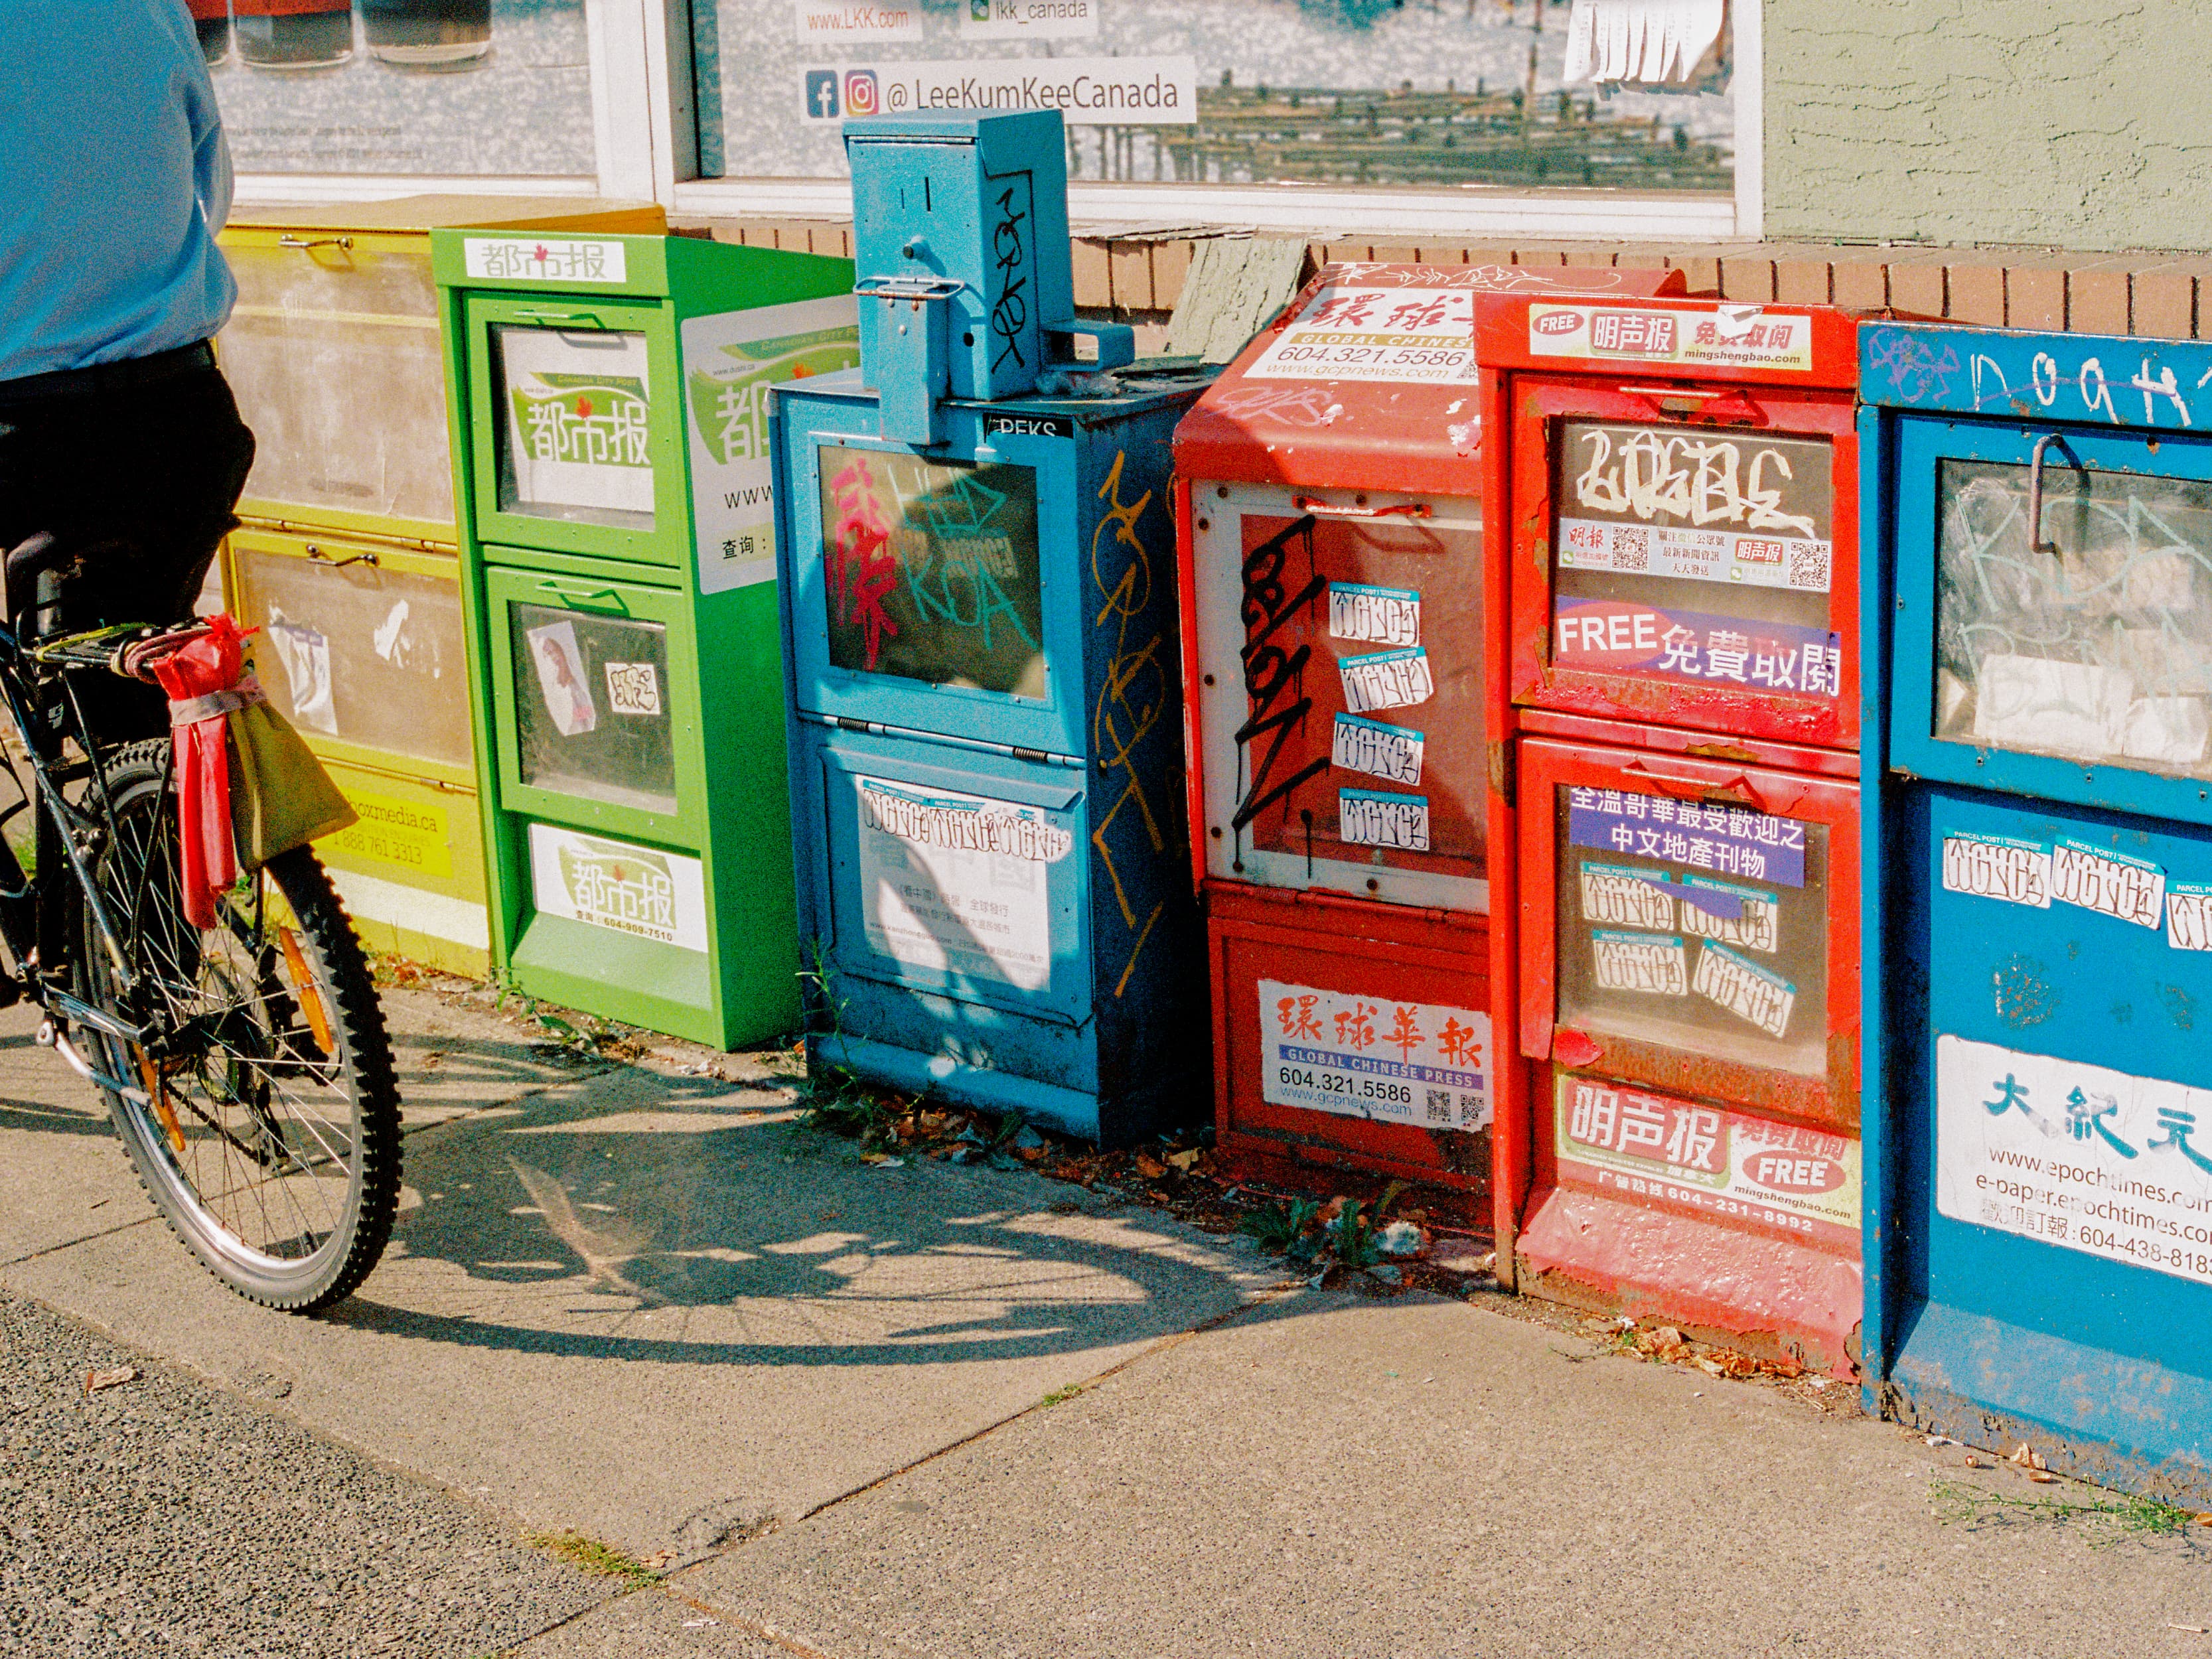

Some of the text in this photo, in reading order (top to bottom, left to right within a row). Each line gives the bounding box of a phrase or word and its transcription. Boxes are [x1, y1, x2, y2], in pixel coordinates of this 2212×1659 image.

[807, 9, 909, 31] www.LKK.com
[995, 1, 1088, 25] lkk_canada
[916, 74, 1179, 109] LeeKumKeeCanada
[481, 243, 607, 279] 都市报
[1540, 314, 1575, 332] FREE
[1593, 315, 1673, 351] 明声报
[1278, 346, 1467, 366] 604.321.5586
[1301, 334, 1474, 348] GLOBAL CHINES
[1684, 349, 1801, 364] mingshengbao.com
[1266, 364, 1449, 380] www.gcpnews.com
[528, 397, 650, 465] 都市报
[1568, 524, 1604, 549] 明報
[1735, 541, 1782, 562] 明声报
[1558, 614, 1657, 653] FREE
[342, 828, 366, 851] 888
[368, 835, 389, 855] 761
[393, 839, 422, 865] 3313
[1611, 823, 1766, 879] 中文地產刊物
[1954, 831, 2000, 844] PARCEL POST
[2067, 839, 2113, 859] PARCEL POST
[572, 861, 674, 929] 都市报
[2176, 884, 2203, 893] PARCEL
[1277, 995, 1483, 1068] 環球華報
[1280, 1066, 1412, 1104] 604.321.5586
[1288, 1048, 1473, 1088] GLOBAL CHINESE PRESS
[1280, 1085, 1412, 1117] www.gcpnews.com
[1570, 1086, 1720, 1170] 明声报
[1982, 1072, 2212, 1175] 大紀元
[1757, 1157, 1828, 1188] FREE
[1667, 1187, 1812, 1234] 604-231-8992
[1734, 1184, 1851, 1220] mingshengbao.com
